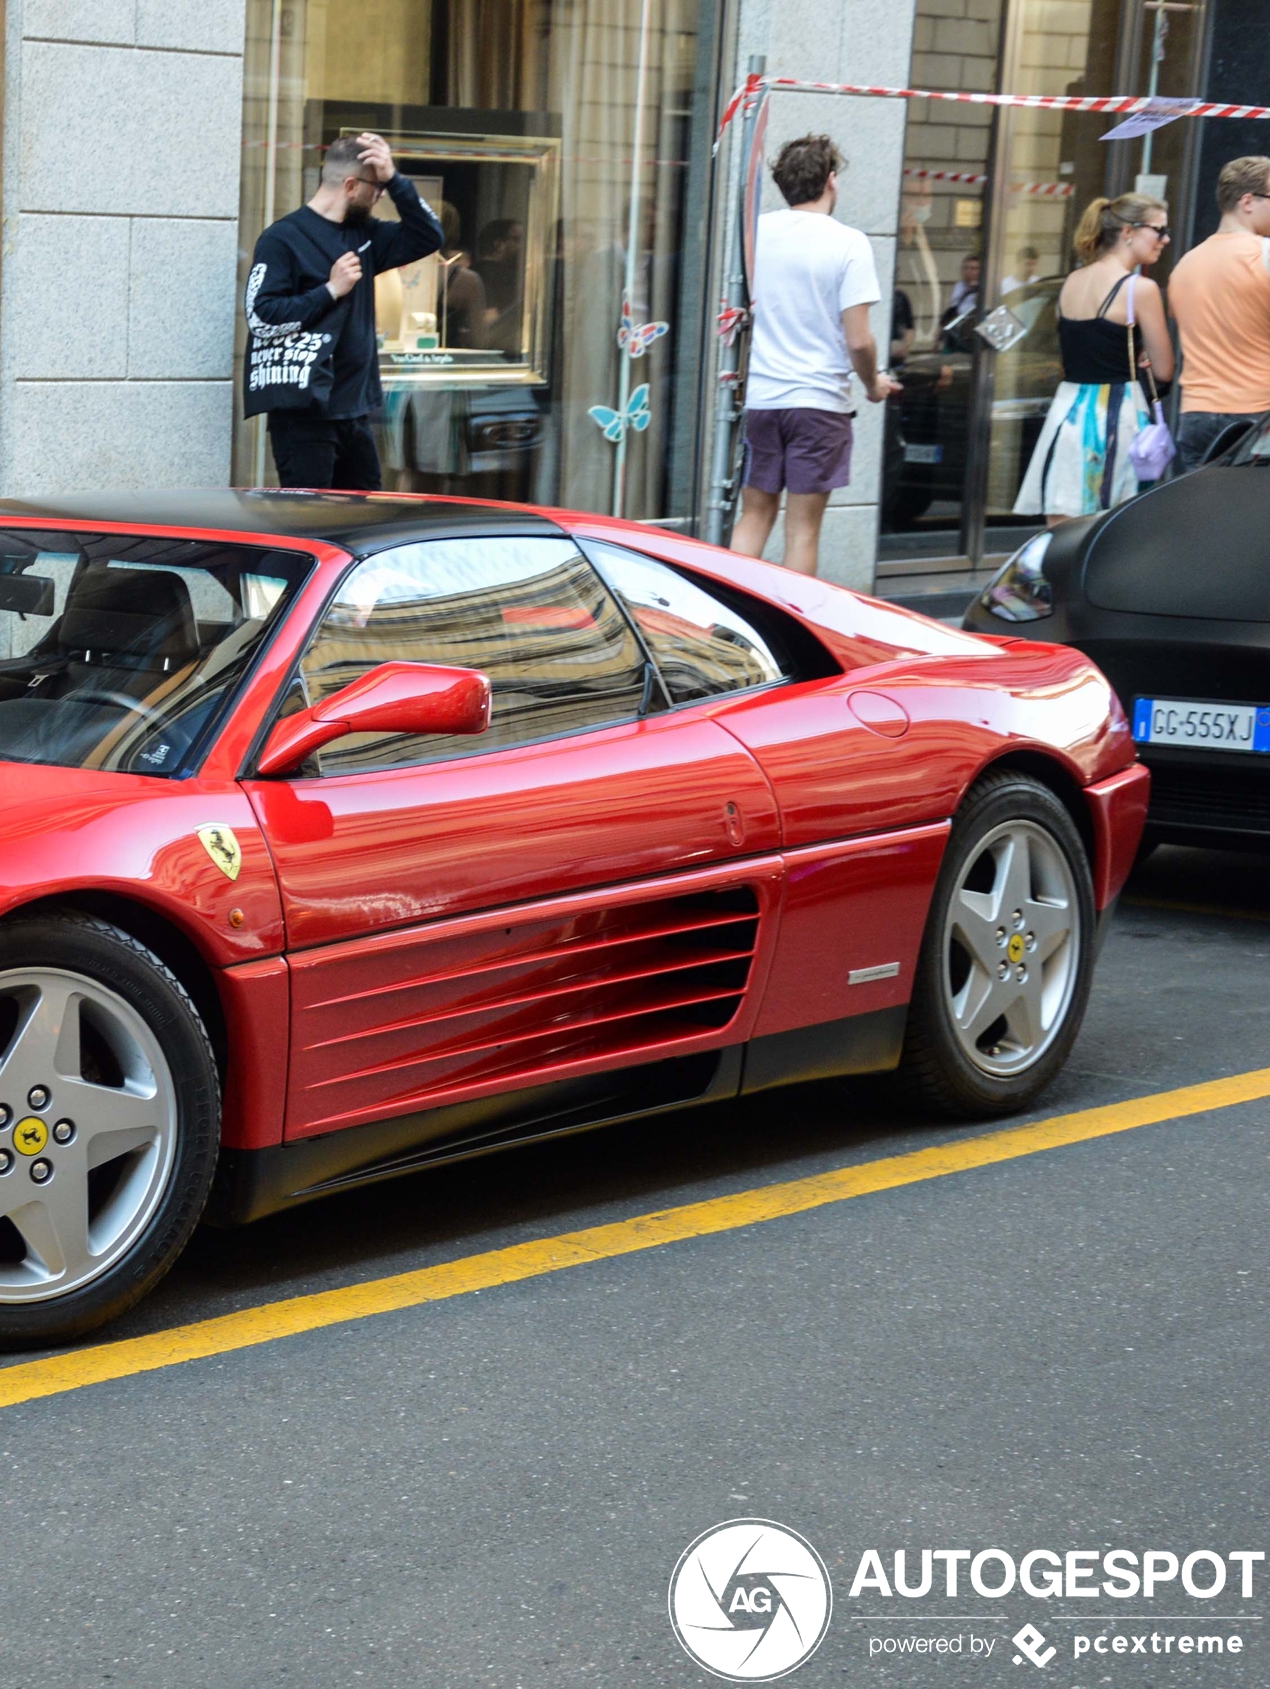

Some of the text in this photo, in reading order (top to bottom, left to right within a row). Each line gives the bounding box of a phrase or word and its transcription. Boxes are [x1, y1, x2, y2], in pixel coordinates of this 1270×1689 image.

[251, 347, 318, 366] never stop
[249, 360, 312, 391] shining
